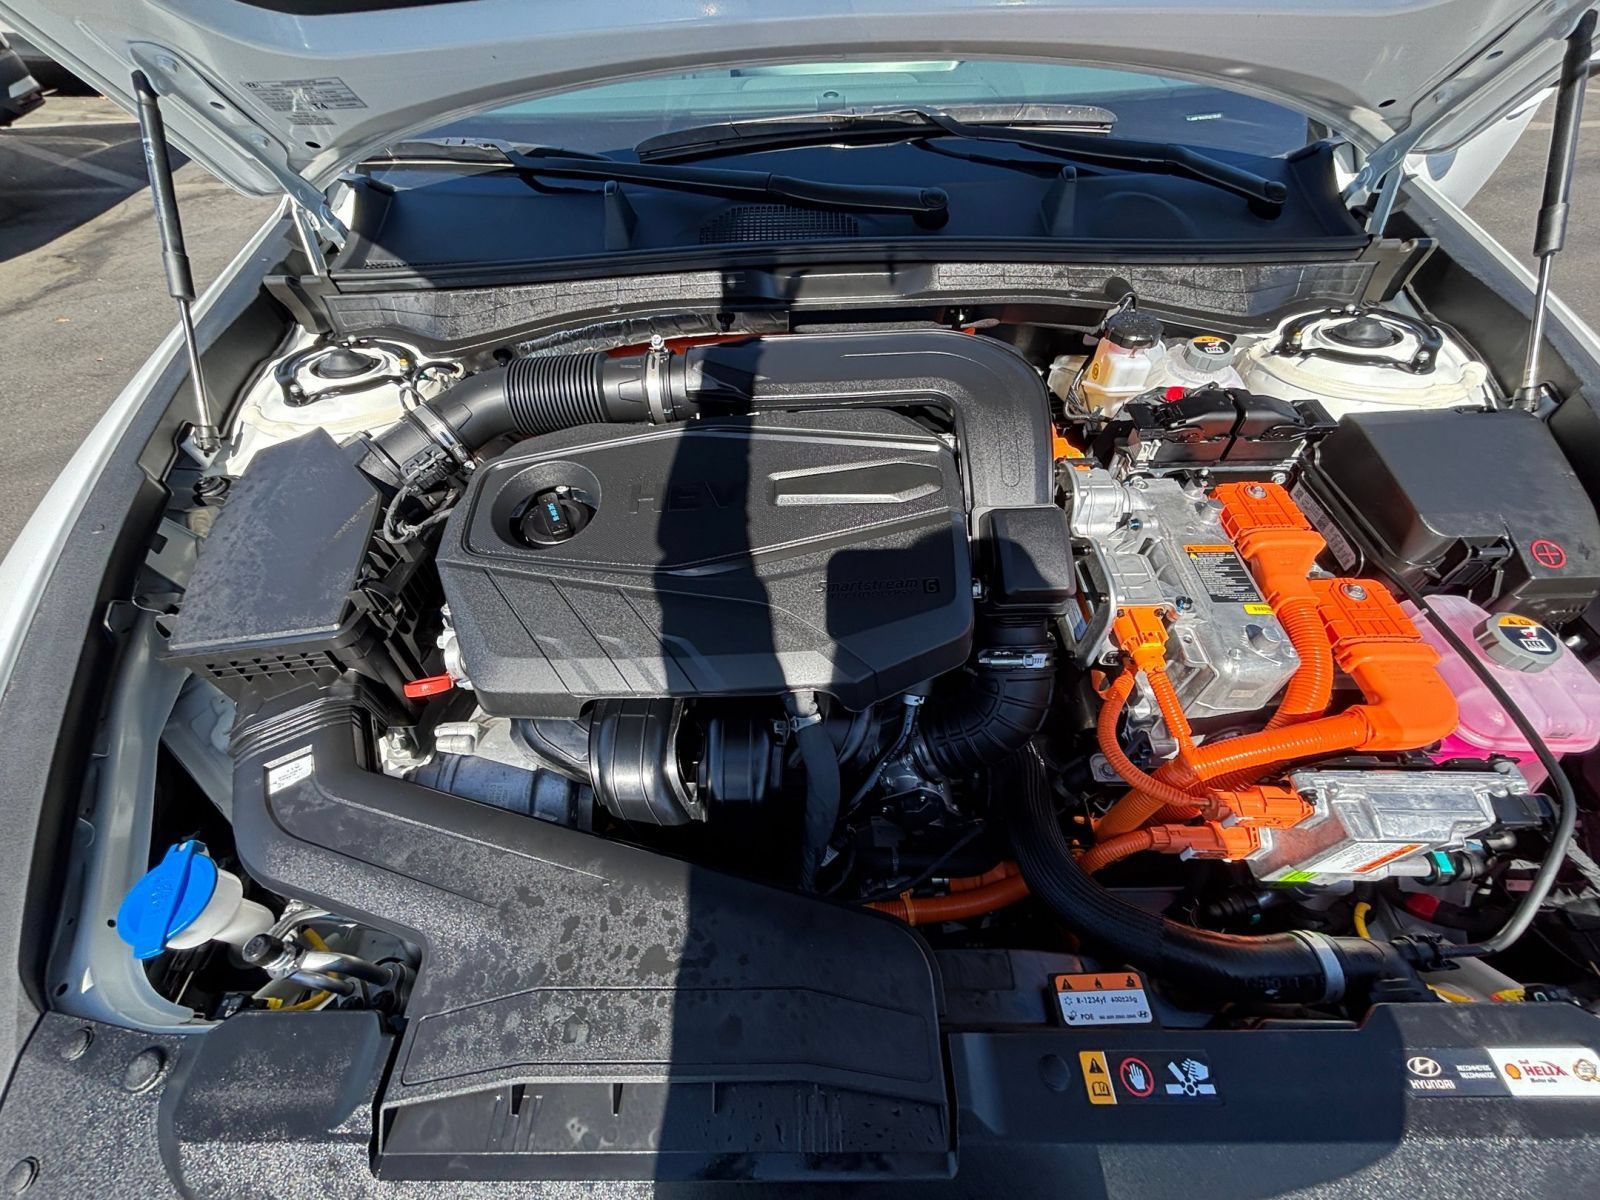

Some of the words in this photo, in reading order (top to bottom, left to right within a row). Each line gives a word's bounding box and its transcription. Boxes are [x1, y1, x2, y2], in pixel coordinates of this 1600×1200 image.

[628, 478, 744, 514] HEV
[815, 579, 918, 592] Smartstream
[1522, 1064, 1569, 1077] HELIX
[1409, 1079, 1457, 1089] HYUNDAI
